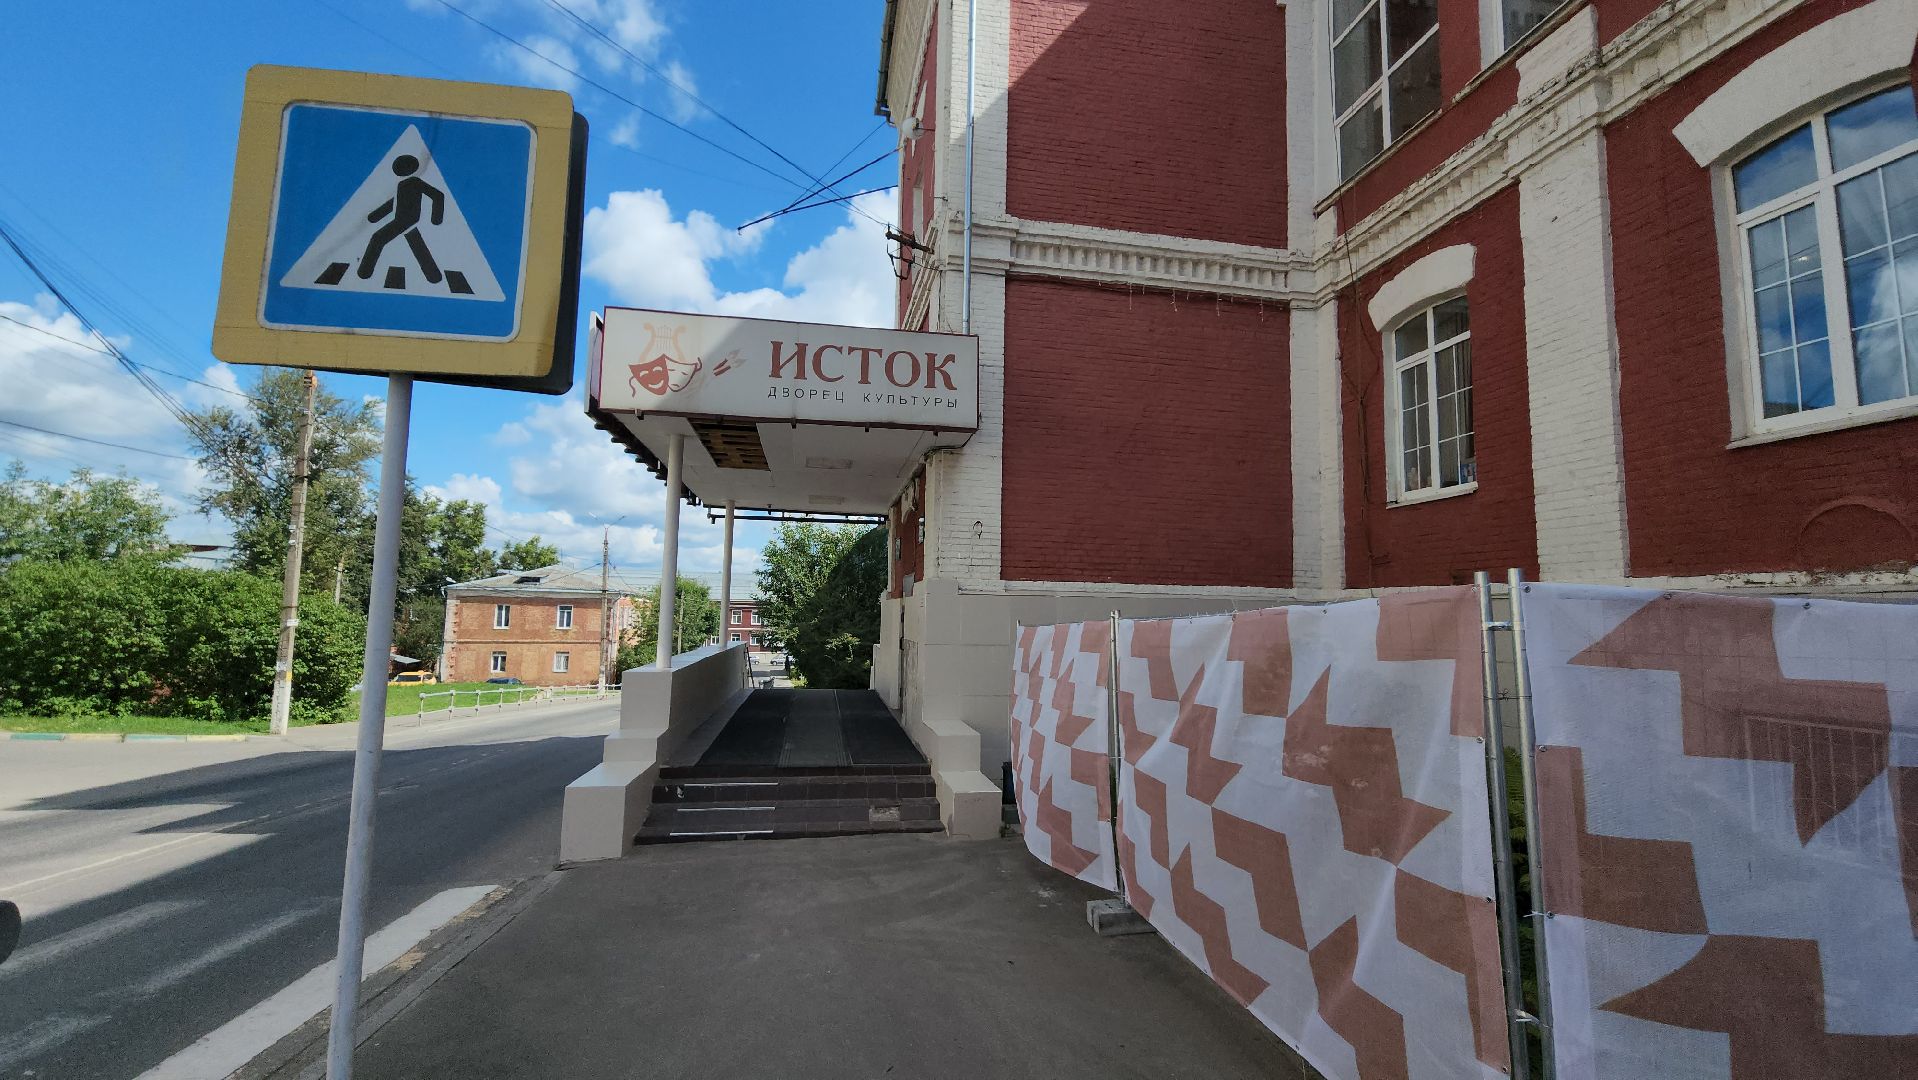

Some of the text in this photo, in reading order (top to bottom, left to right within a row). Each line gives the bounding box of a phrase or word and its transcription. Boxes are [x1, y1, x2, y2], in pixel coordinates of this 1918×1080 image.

[769, 340, 957, 390] ИСТОК
[768, 386, 957, 408] ДВОРЕЦ КУЛЬТУРЫ
